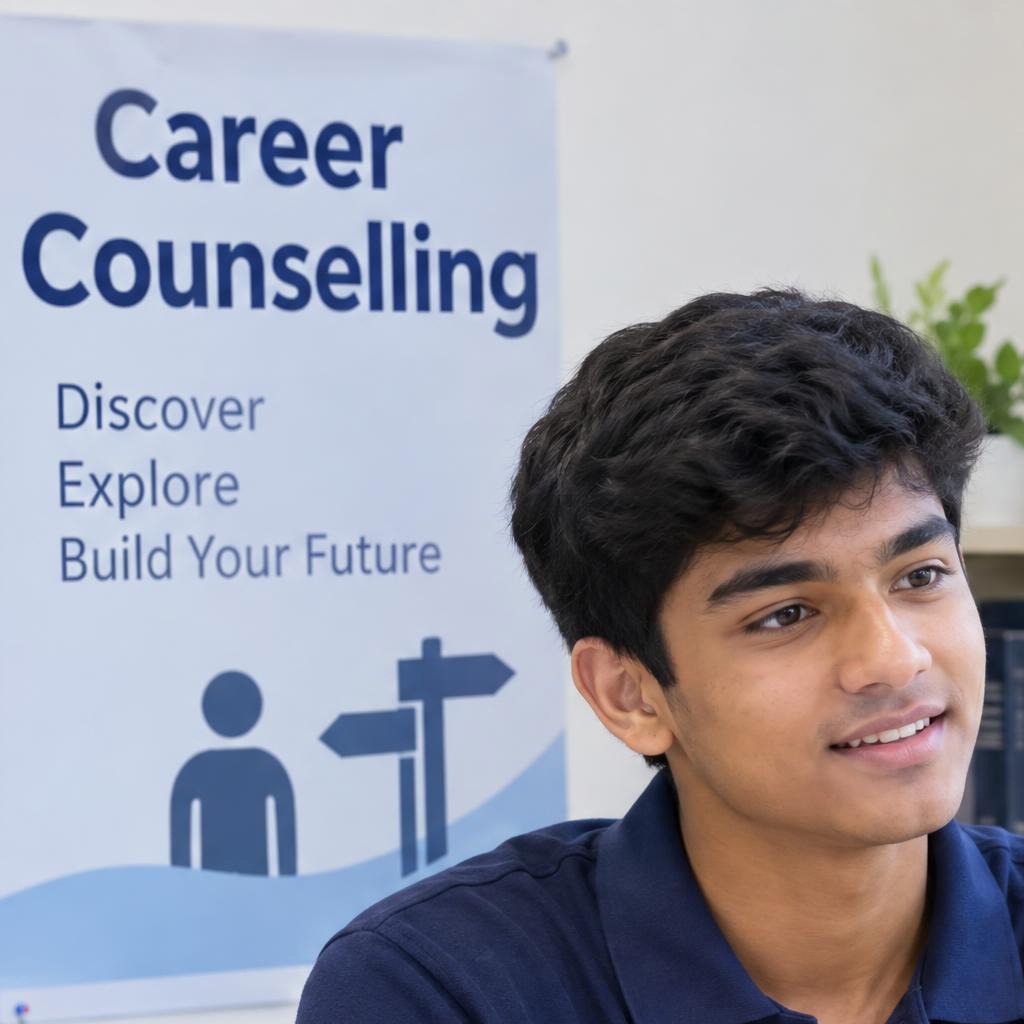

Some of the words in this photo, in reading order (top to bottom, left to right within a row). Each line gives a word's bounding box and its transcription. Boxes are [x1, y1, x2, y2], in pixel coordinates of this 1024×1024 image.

[95, 88, 404, 190] Career
[21, 211, 538, 339] Counselling
[57, 381, 265, 432] Discover
[58, 458, 240, 520] Explore
[60, 533, 173, 583] Build
[187, 534, 291, 580] Your
[306, 533, 442, 576] Future
